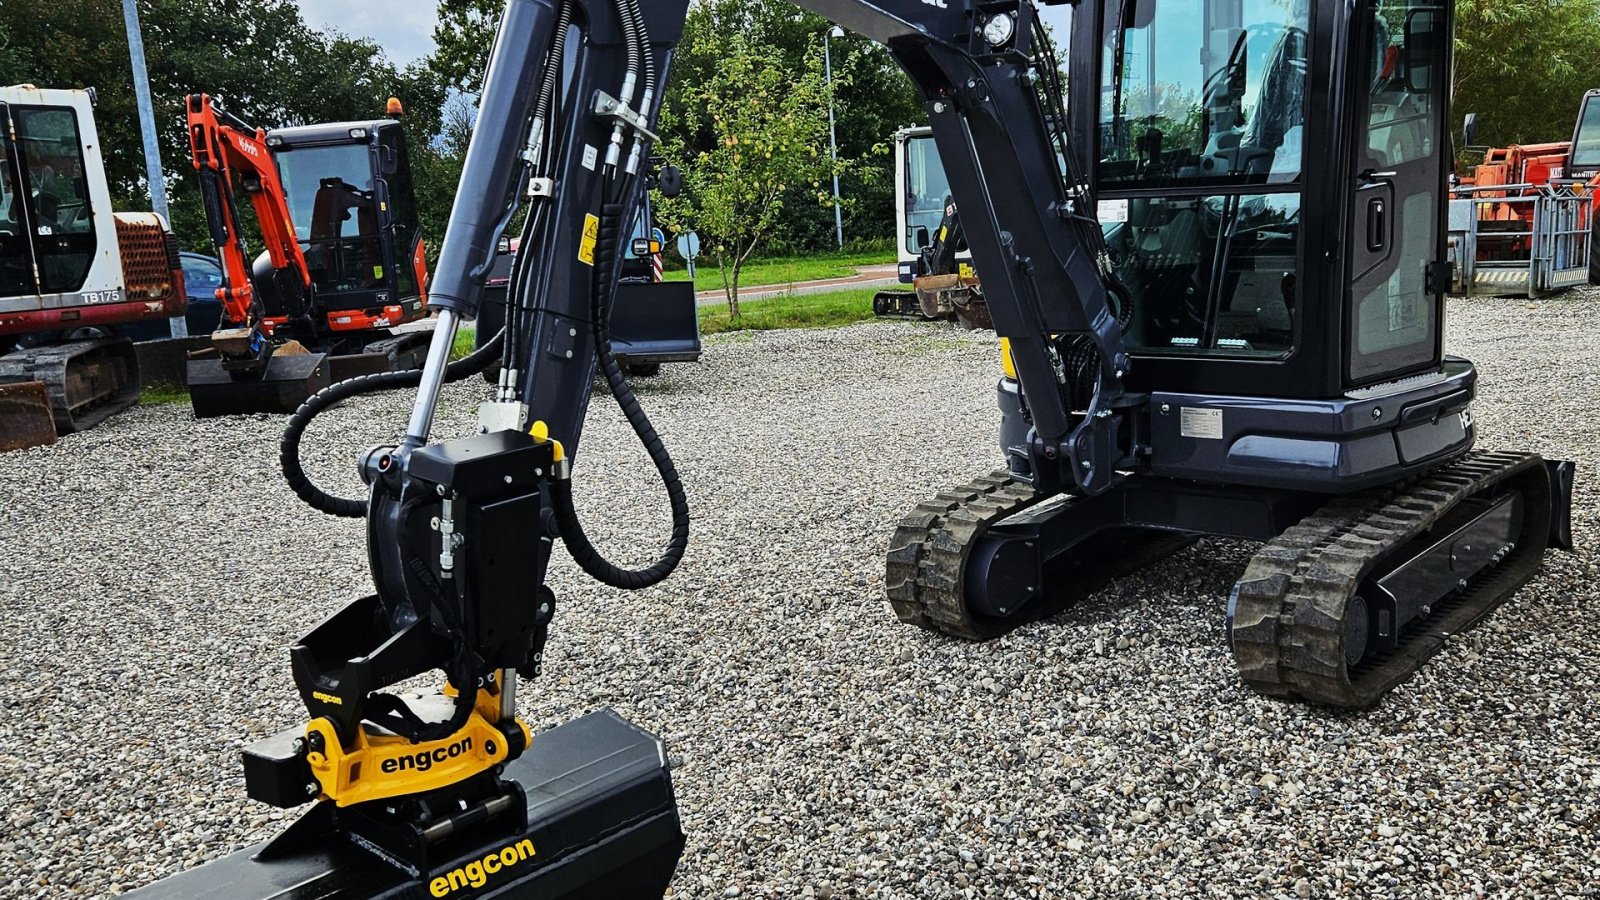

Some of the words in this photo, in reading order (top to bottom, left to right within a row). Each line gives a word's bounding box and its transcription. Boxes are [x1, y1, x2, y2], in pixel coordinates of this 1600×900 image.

[81, 290, 120, 304] TB175
[312, 691, 342, 705] engcon
[381, 736, 472, 773] engcon
[429, 838, 536, 898] engcon
